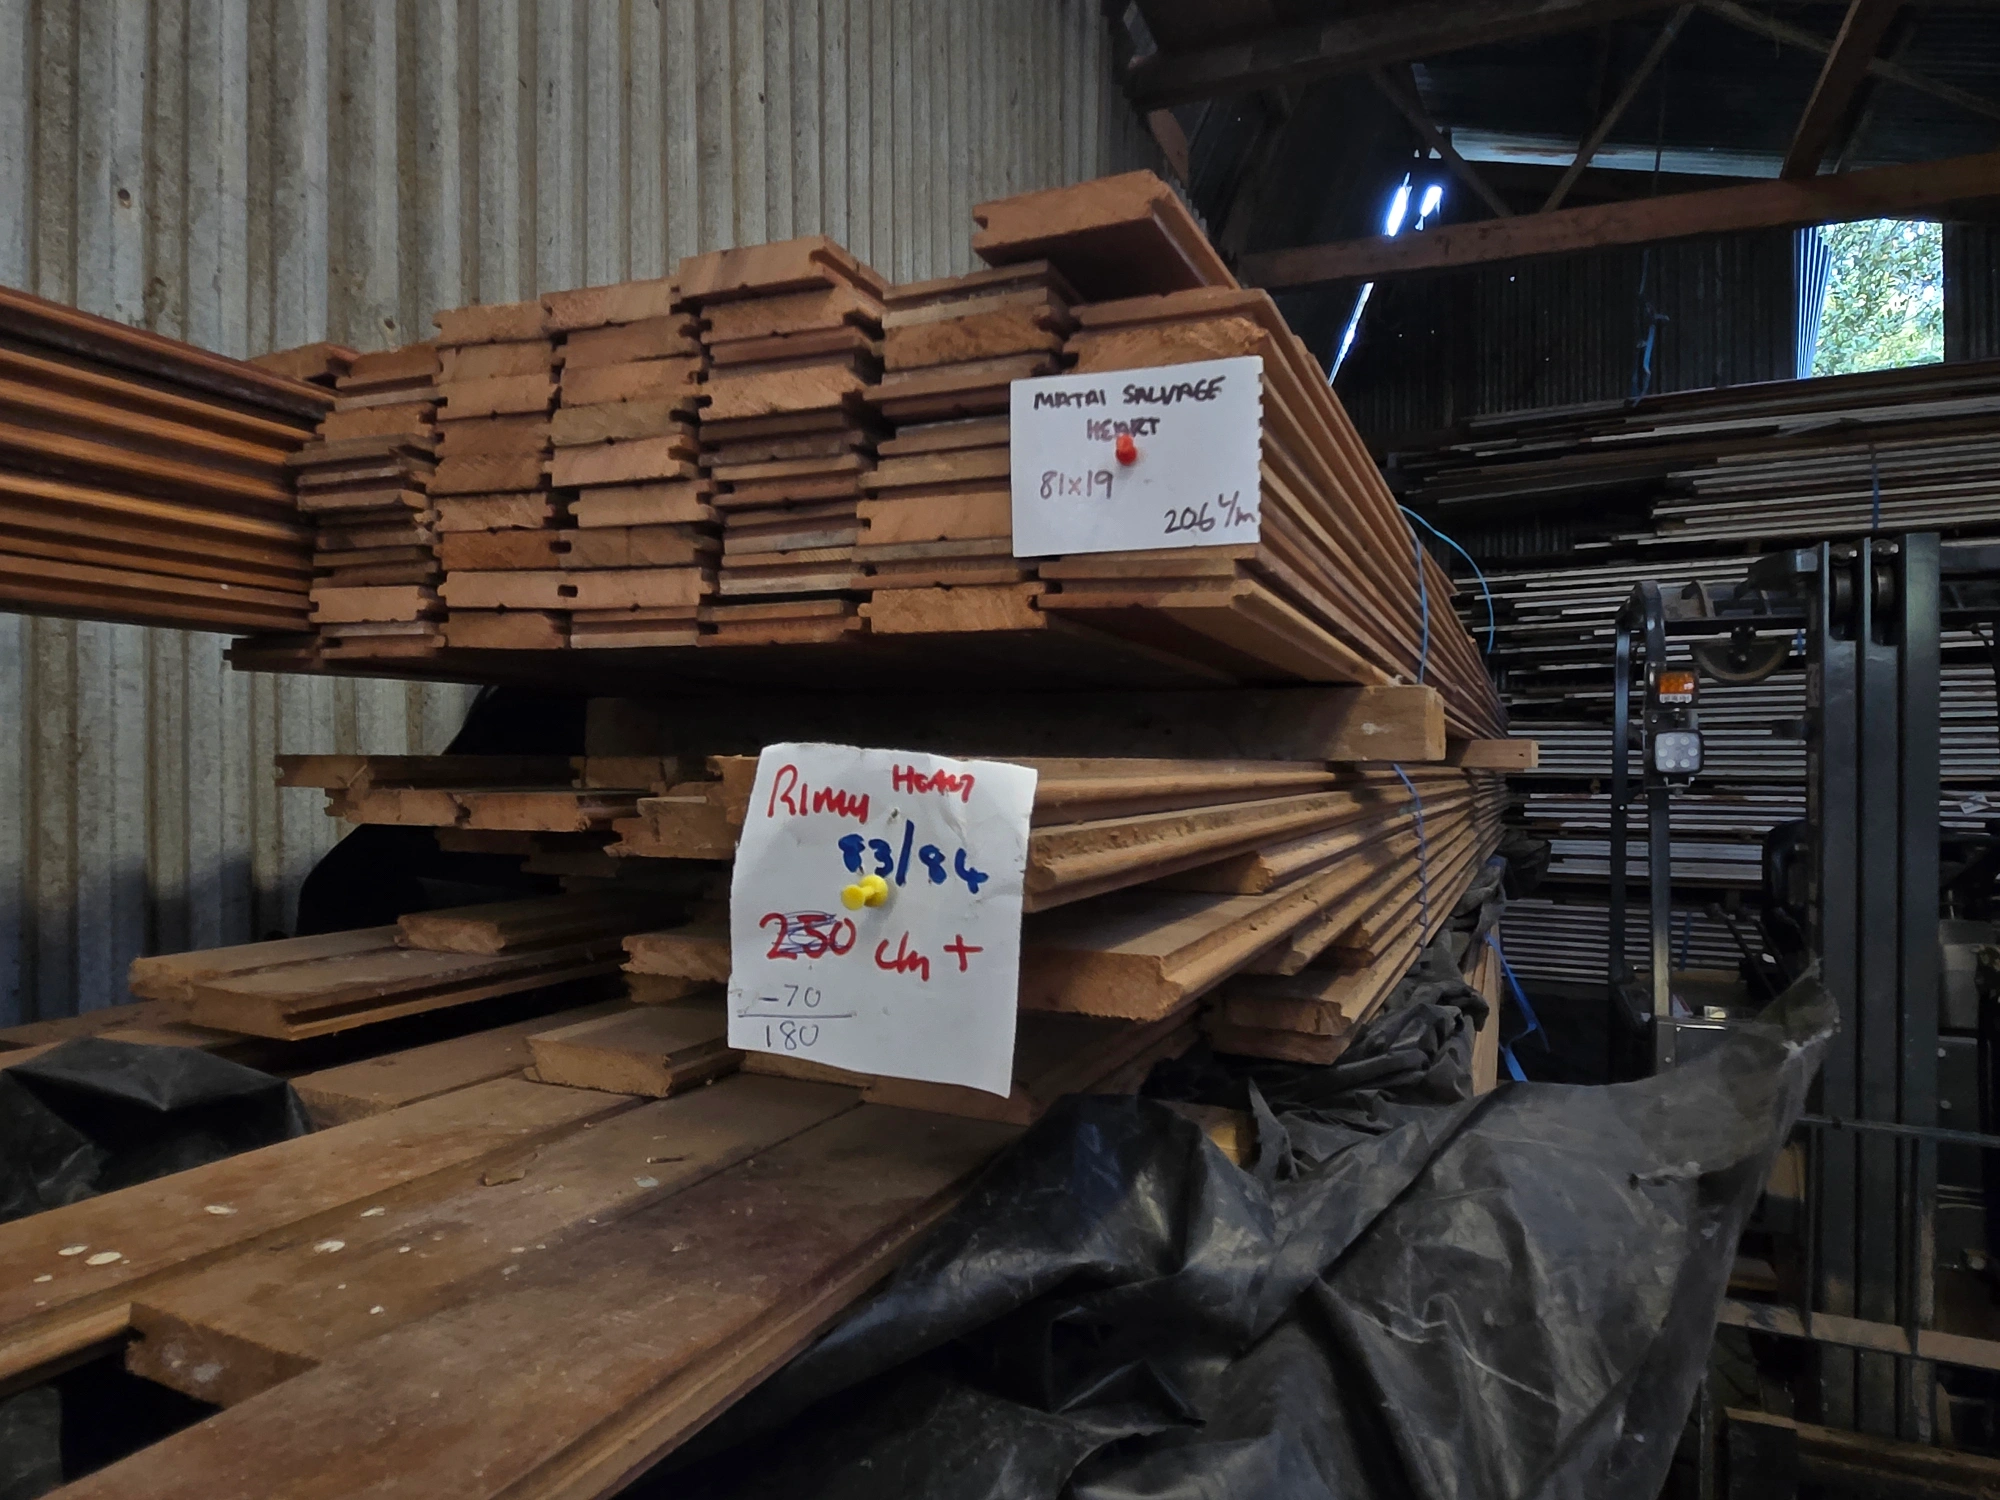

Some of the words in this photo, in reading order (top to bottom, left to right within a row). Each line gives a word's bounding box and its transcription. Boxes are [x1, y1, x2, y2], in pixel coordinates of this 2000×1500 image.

[1034, 389, 1106, 410] MATAI
[1122, 376, 1225, 404] SALVAGE
[765, 1020, 820, 1050] 180
